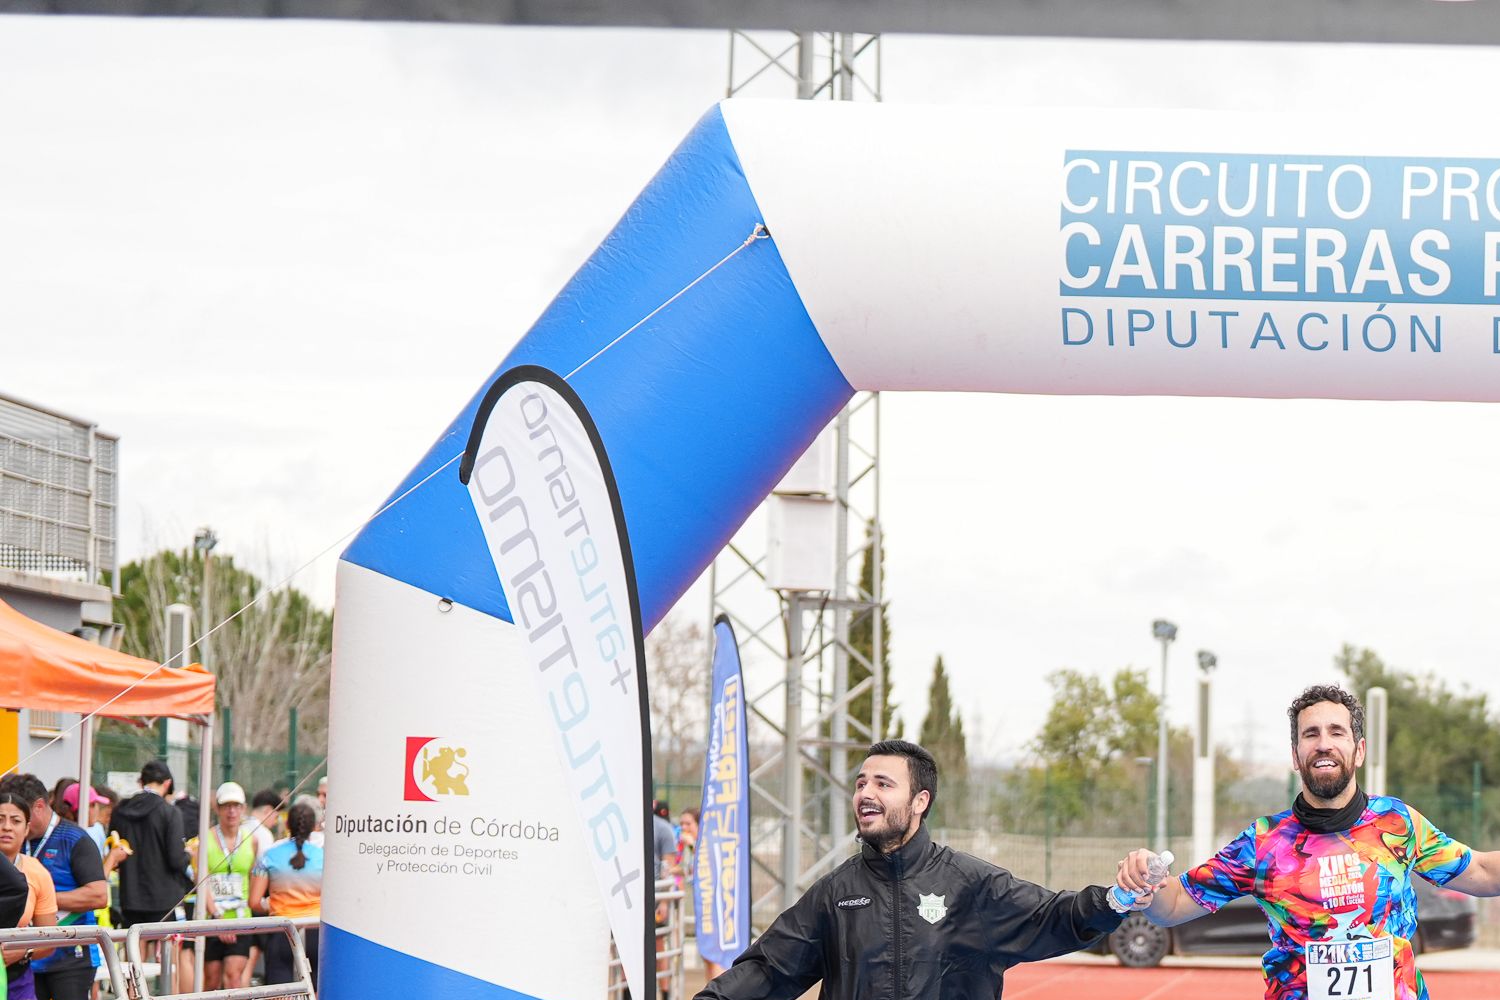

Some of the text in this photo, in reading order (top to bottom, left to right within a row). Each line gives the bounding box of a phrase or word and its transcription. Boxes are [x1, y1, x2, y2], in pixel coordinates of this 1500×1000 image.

[1061, 158, 1372, 220] CIRCUITO
[1059, 221, 1452, 297] CARRERAS
[1061, 303, 1443, 354] DIPUTACIÓN
[335, 813, 560, 841] Diputación de Córdoba
[358, 842, 518, 860] Delegación de Deportes
[376, 860, 492, 876] y Protección Civil
[1320, 874, 1348, 888] MEDIA
[1321, 881, 1364, 899] MARATÓN
[1327, 964, 1373, 996] 271
